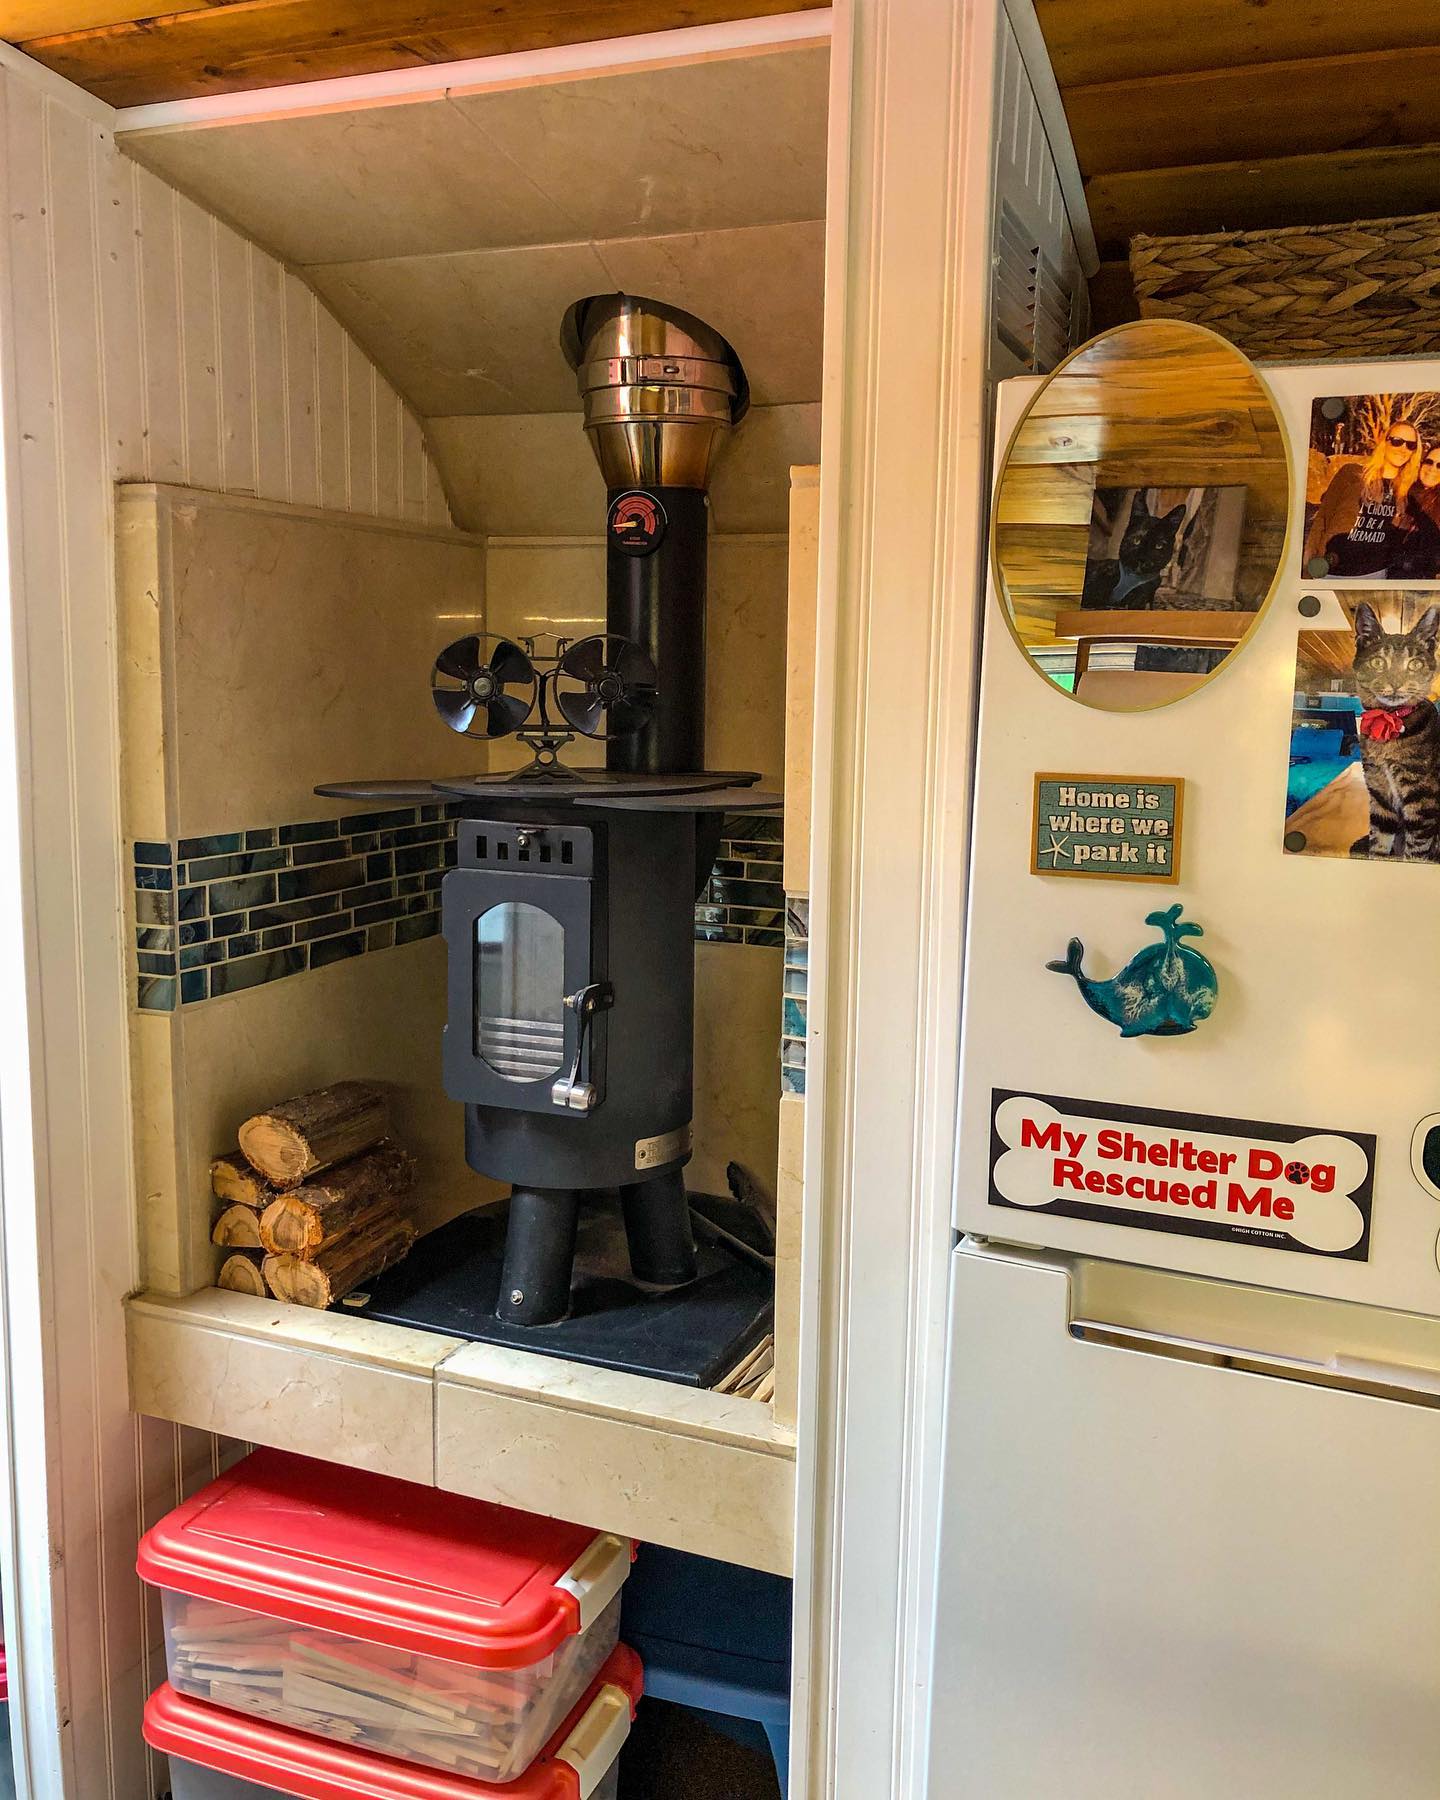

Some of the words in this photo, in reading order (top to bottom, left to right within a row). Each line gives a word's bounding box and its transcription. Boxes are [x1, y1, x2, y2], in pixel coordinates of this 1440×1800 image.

[1354, 516, 1365, 528] TO
[1366, 517, 1377, 529] BE
[1377, 520, 1384, 529] A
[1058, 787, 1129, 809] Home
[1136, 789, 1160, 810] is
[1049, 812, 1125, 835] where
[1131, 818, 1169, 837] we
[1073, 842, 1139, 865] park
[1147, 843, 1168, 864] it
[1021, 1118, 1087, 1157] My
[1097, 1130, 1236, 1175] Shelter
[1248, 1148, 1336, 1193] Dog
[1052, 1158, 1216, 1209] Rescued
[1227, 1187, 1295, 1221] Me
